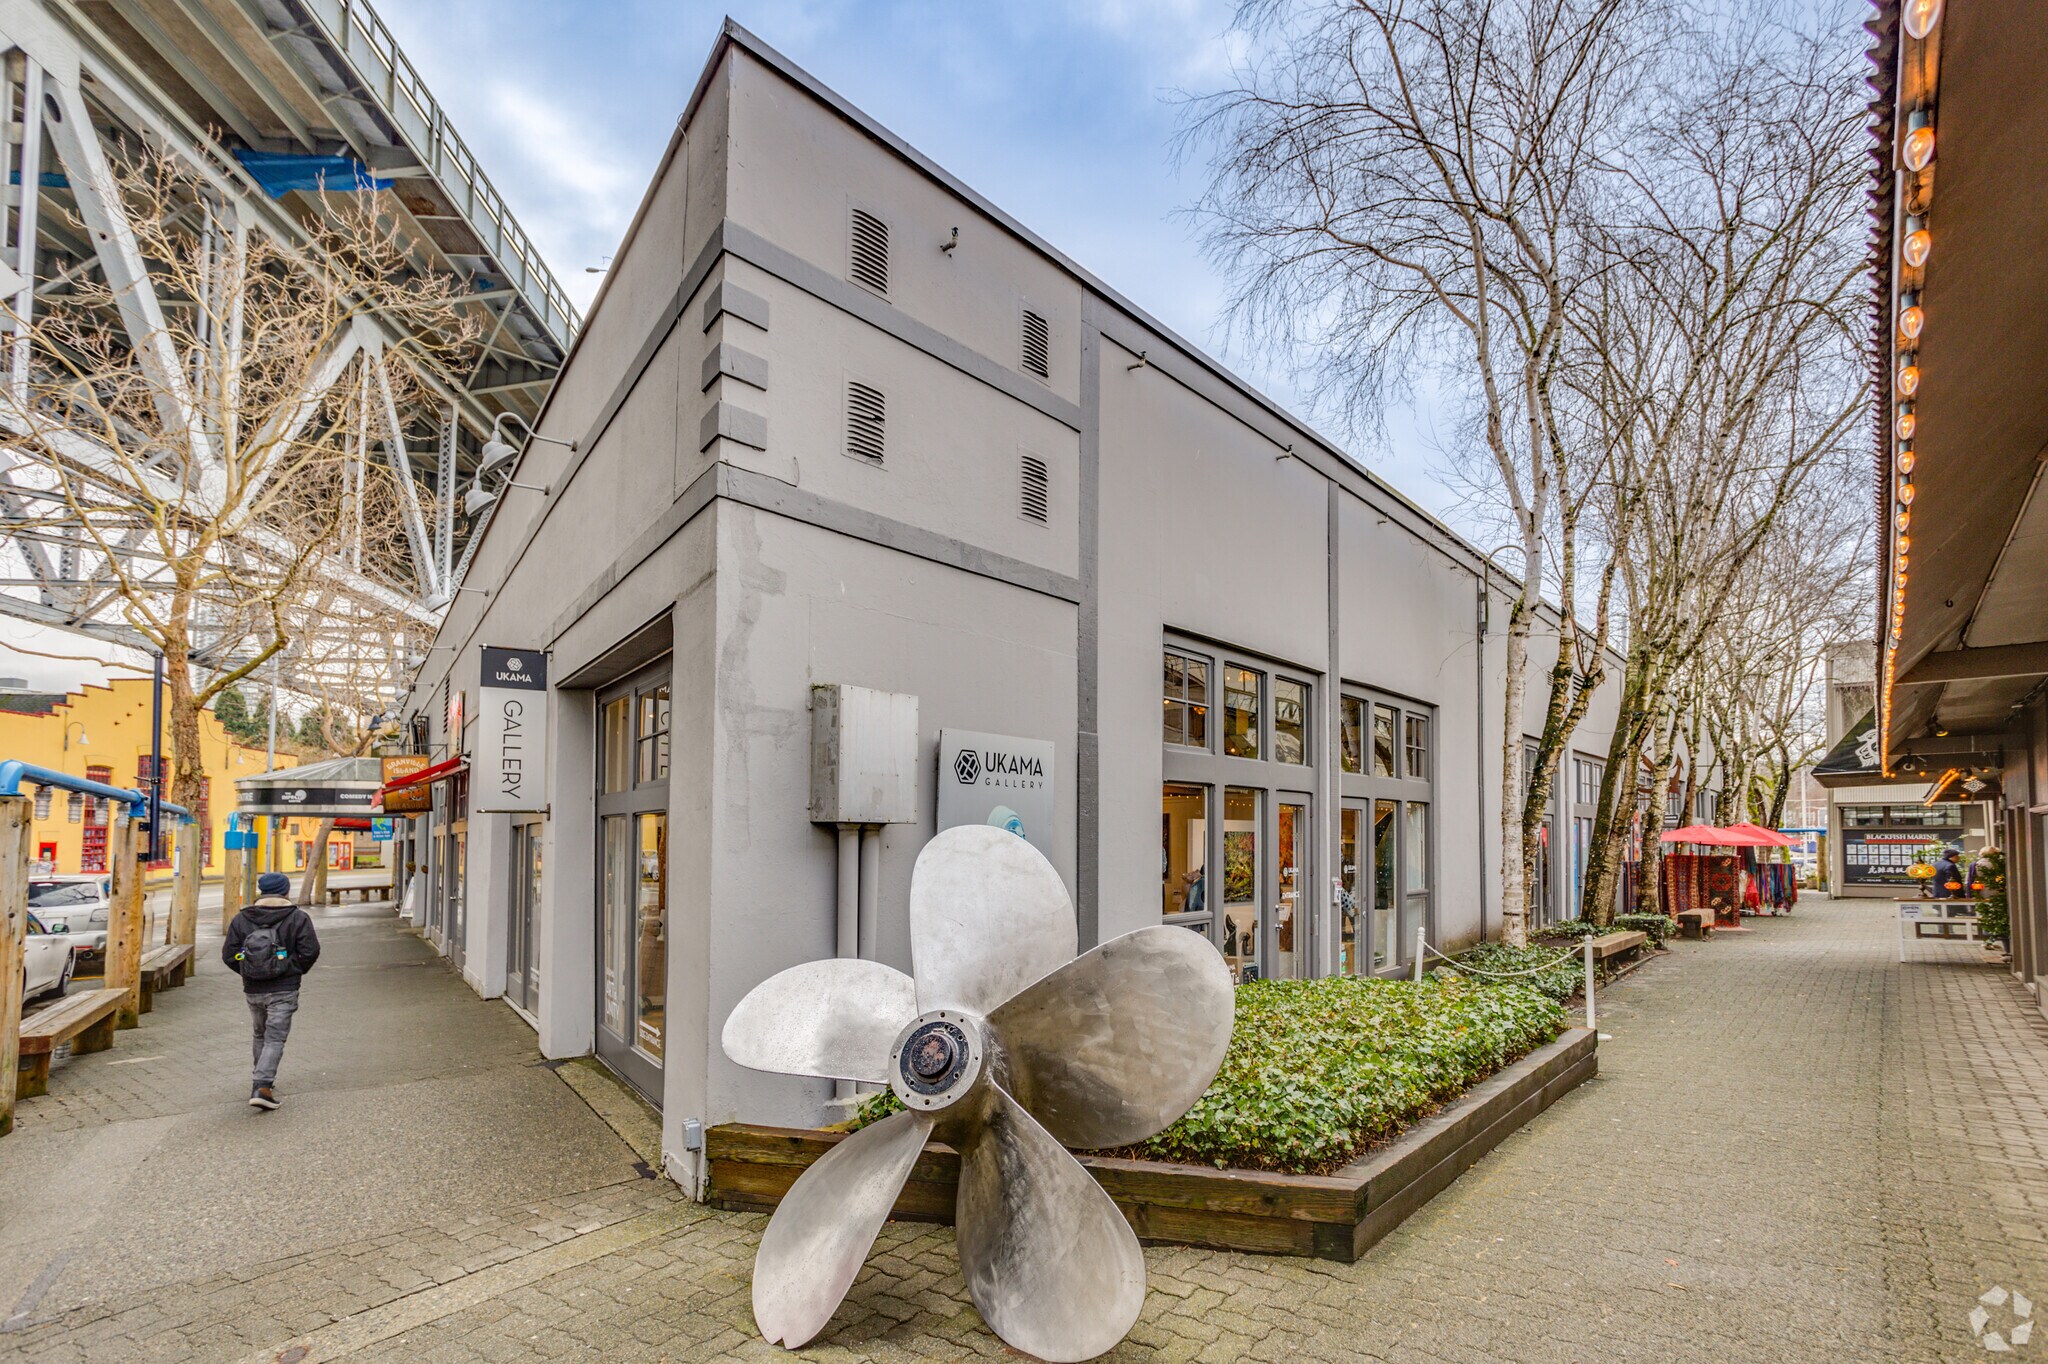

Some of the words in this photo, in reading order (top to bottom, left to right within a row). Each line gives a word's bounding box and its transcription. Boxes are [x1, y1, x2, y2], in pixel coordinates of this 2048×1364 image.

[496, 671, 532, 683] UKAMA
[502, 700, 523, 799] GALLERY
[386, 758, 426, 770] GRANVILLE
[985, 751, 1043, 777] UKAMA
[985, 777, 1043, 789] GALLERY
